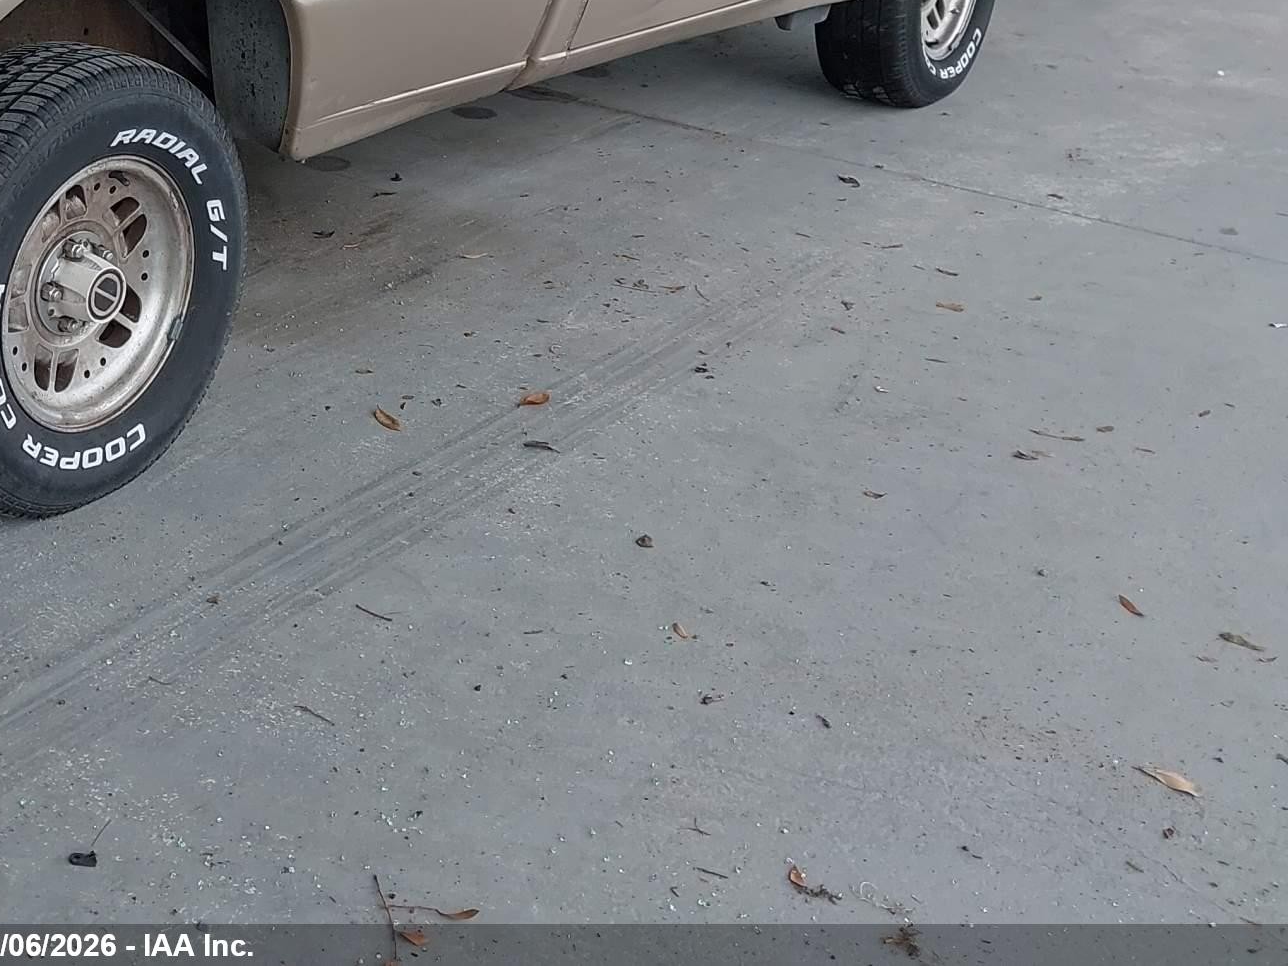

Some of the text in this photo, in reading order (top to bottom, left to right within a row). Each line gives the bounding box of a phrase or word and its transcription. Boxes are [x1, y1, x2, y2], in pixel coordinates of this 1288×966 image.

[939, 28, 982, 79] COOPER
[111, 129, 228, 270] RADIAL G/T
[22, 423, 146, 470] COOPER
